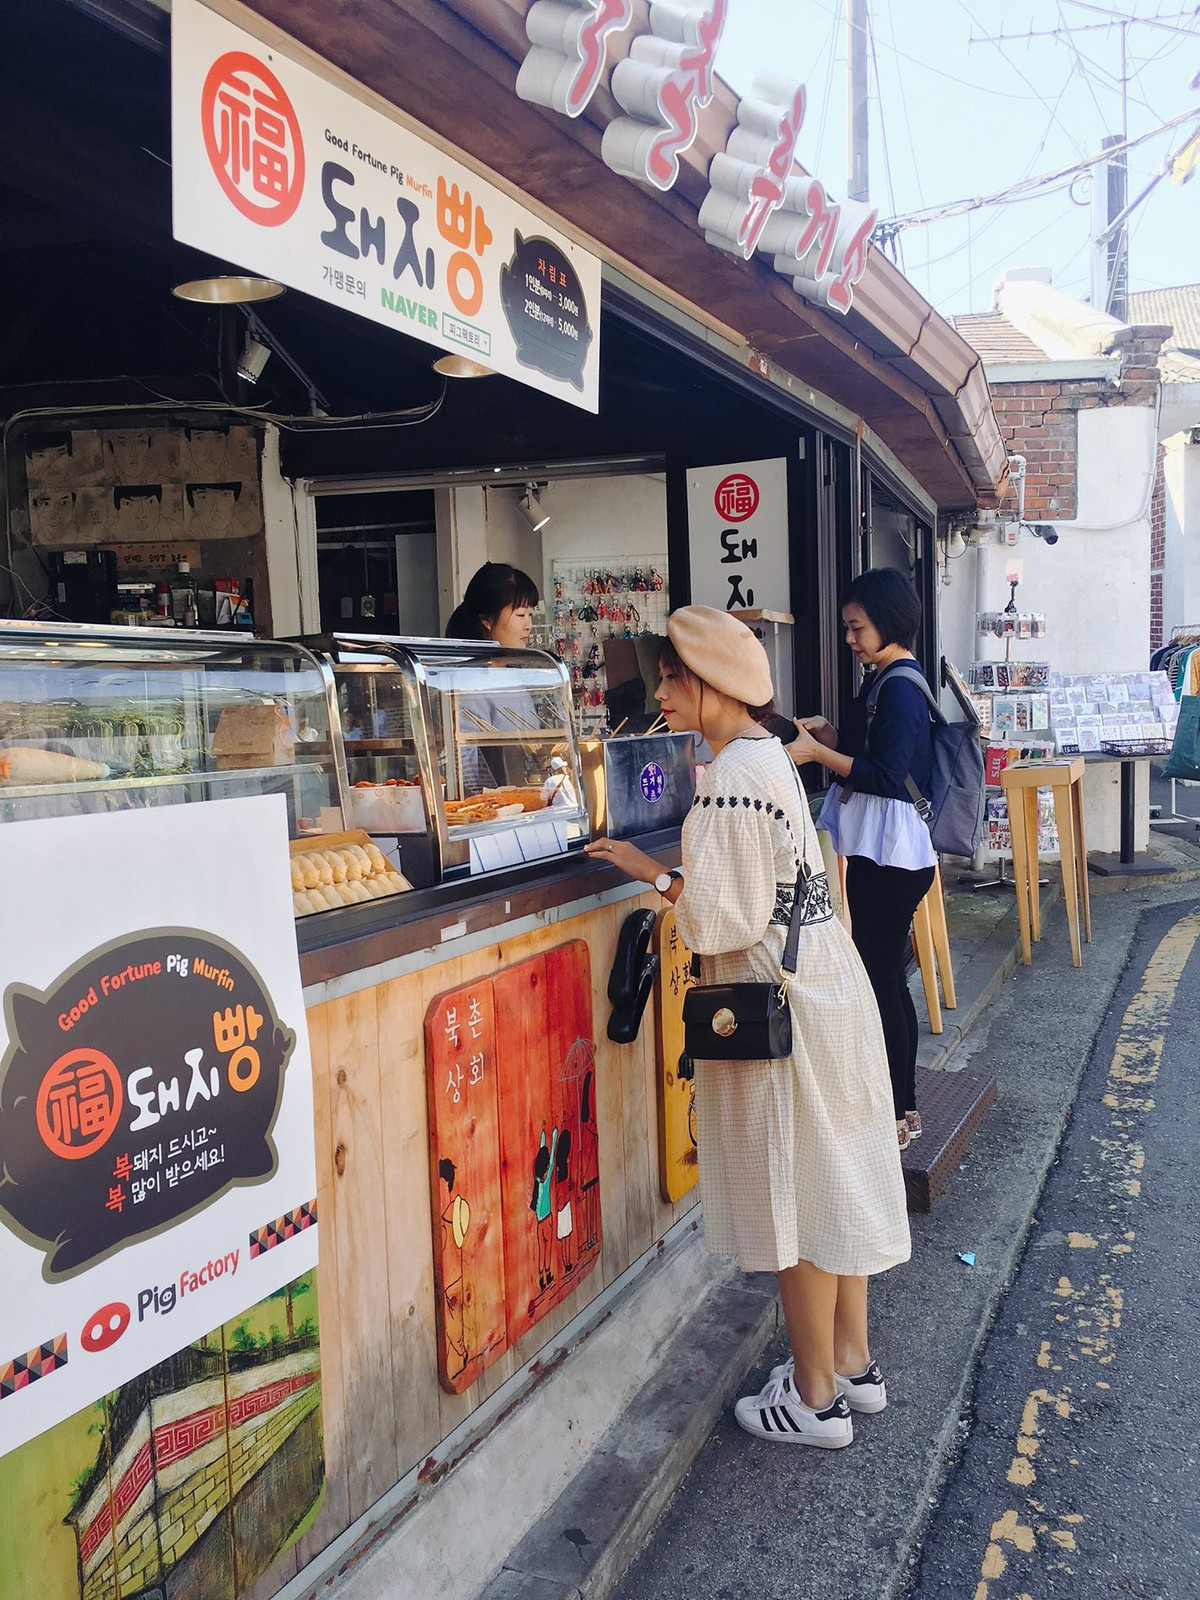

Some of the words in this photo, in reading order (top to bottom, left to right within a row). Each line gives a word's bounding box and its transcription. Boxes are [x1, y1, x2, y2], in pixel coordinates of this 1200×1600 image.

[211, 65, 297, 211] 福
[324, 128, 349, 152] Good
[352, 143, 388, 173] Fortune
[390, 164, 404, 185] Pig
[406, 174, 433, 199] Murfin
[323, 265, 367, 300] 가맹문의
[381, 287, 439, 330] NAVER
[449, 323, 481, 347] 피그팩토리
[719, 478, 755, 518] 福
[720, 529, 758, 611] 돼지
[991, 757, 1001, 778] BTS
[58, 986, 98, 1031] Good
[101, 961, 162, 996] Fortune
[166, 953, 189, 978] Pig
[193, 956, 235, 992] Murfin
[445, 998, 484, 1047] 북촌
[445, 1051, 484, 1103] 상회
[47, 1060, 116, 1149] 福
[167, 1127, 217, 1158] 드시고~
[105, 1184, 126, 1212] 복
[132, 1171, 161, 1204] 많이
[165, 1144, 225, 1188] 받으세요!
[138, 1283, 177, 1322] Pig
[180, 1249, 240, 1298] Factory
